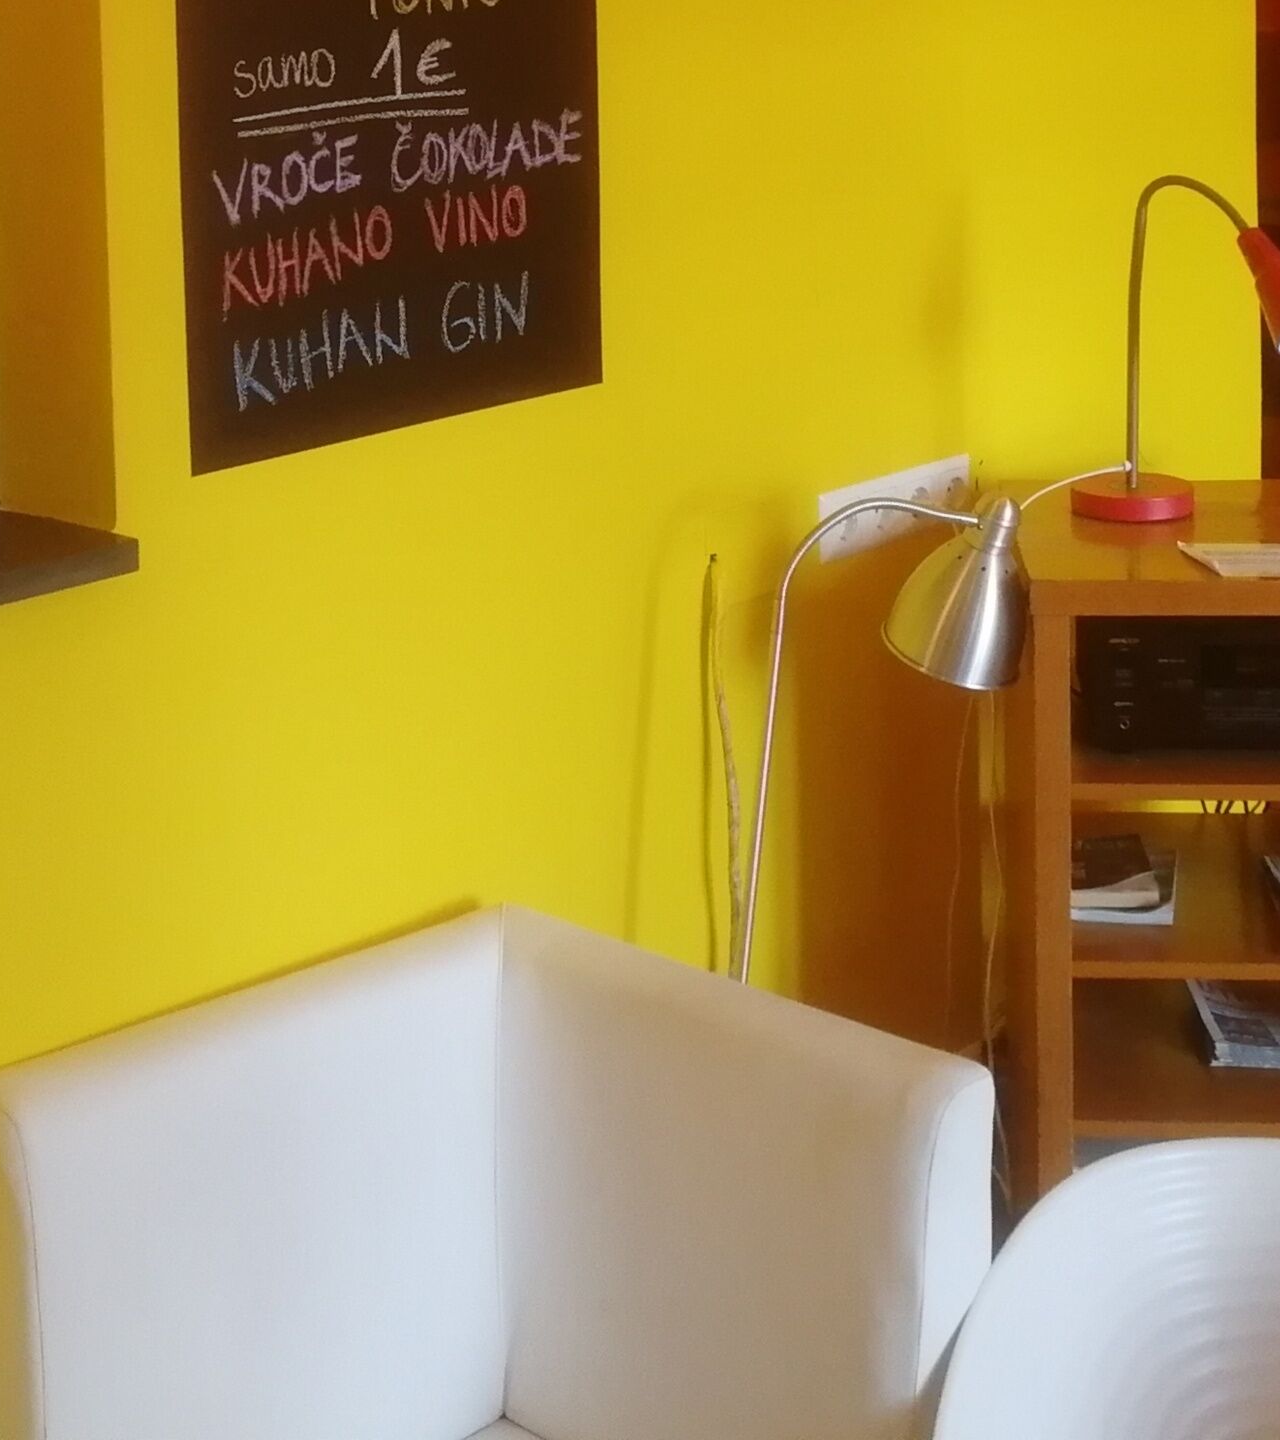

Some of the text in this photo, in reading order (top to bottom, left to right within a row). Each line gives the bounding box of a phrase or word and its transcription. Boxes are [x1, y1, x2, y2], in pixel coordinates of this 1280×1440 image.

[233, 28, 457, 98] samo 1€
[213, 108, 583, 226] VROČE ČOKOLADE
[222, 185, 528, 321] KUHANO VINO
[233, 271, 530, 412] KUHAN GIN
